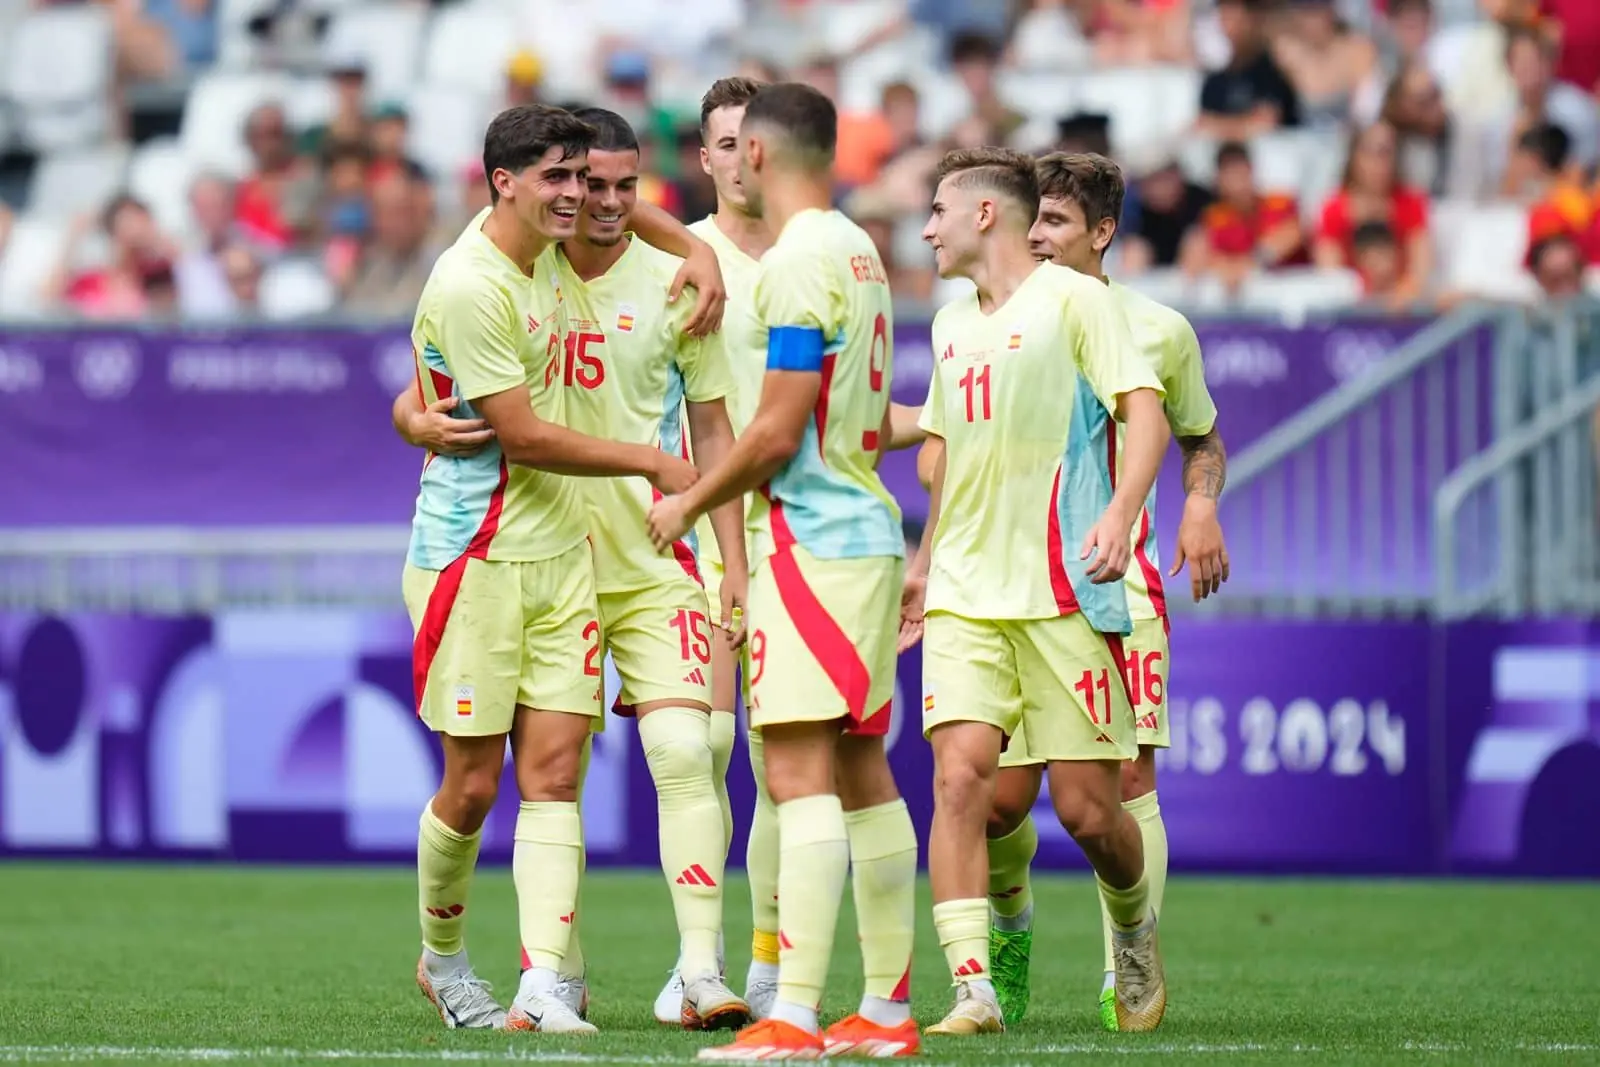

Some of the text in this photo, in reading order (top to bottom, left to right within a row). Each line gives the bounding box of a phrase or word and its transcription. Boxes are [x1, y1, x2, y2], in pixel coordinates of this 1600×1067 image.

[563, 330, 605, 389] 15
[959, 364, 991, 422] 11
[669, 609, 711, 665] 15
[751, 628, 767, 687] 9
[1074, 668, 1111, 724] 11
[1125, 650, 1163, 706] 16
[1239, 696, 1406, 776] 2024
